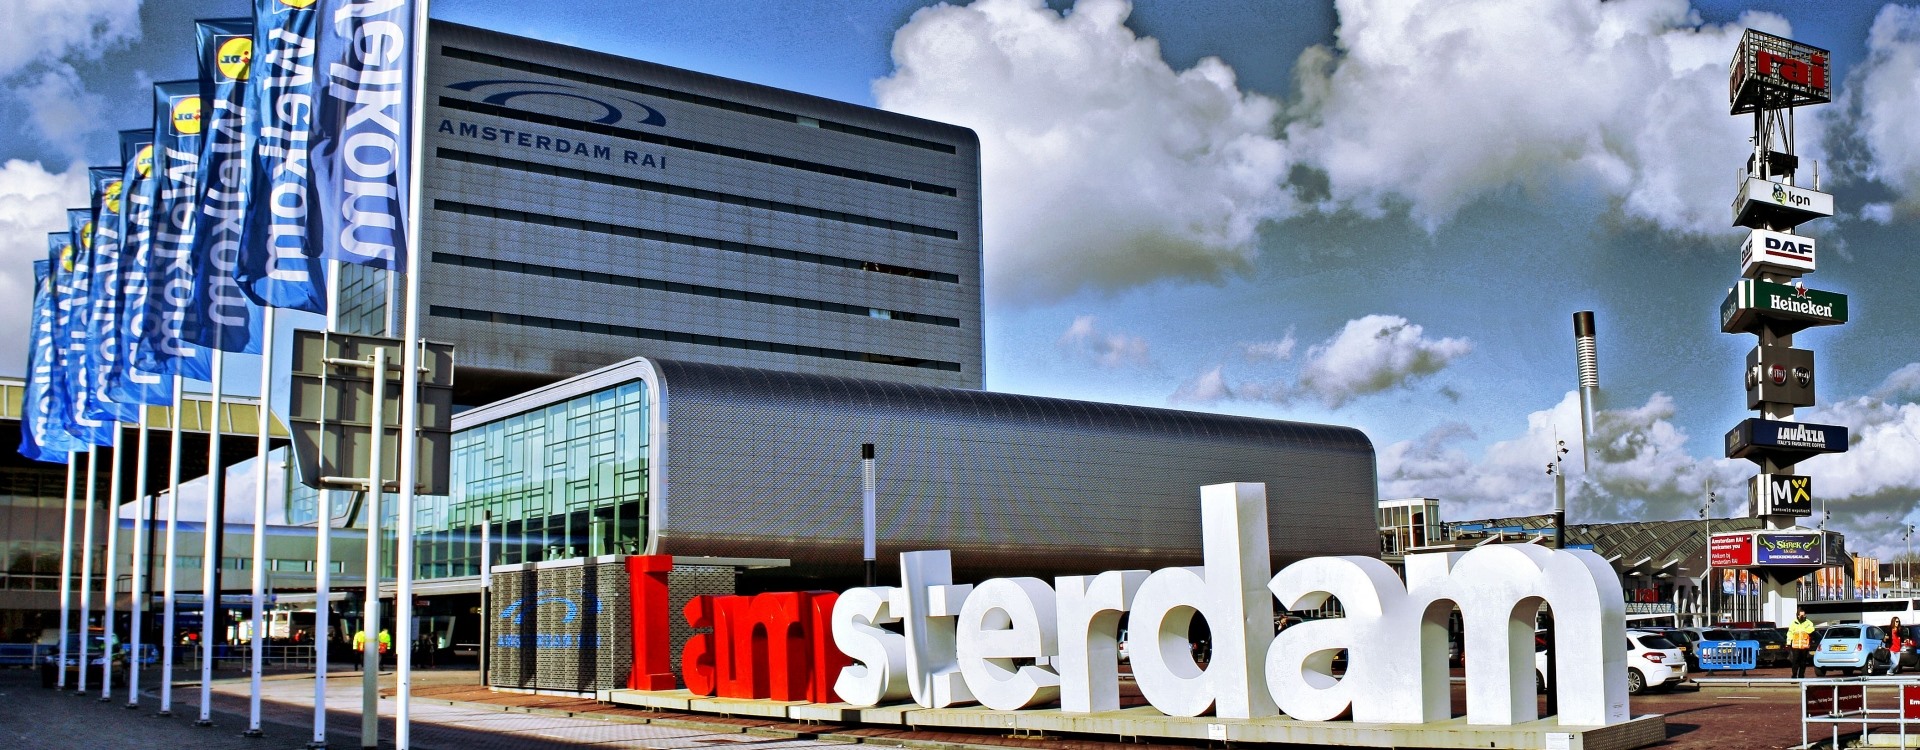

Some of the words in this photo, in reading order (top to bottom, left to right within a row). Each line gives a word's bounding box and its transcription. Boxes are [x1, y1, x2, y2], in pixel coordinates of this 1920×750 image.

[1756, 50, 1825, 90] rai
[438, 118, 611, 162] AMSTERDAM
[624, 149, 668, 170] RAI
[1788, 190, 1811, 207] kpn
[1765, 237, 1813, 255] DAF
[1770, 294, 1833, 318] Heineken
[1776, 424, 1826, 443] LAVAZZA
